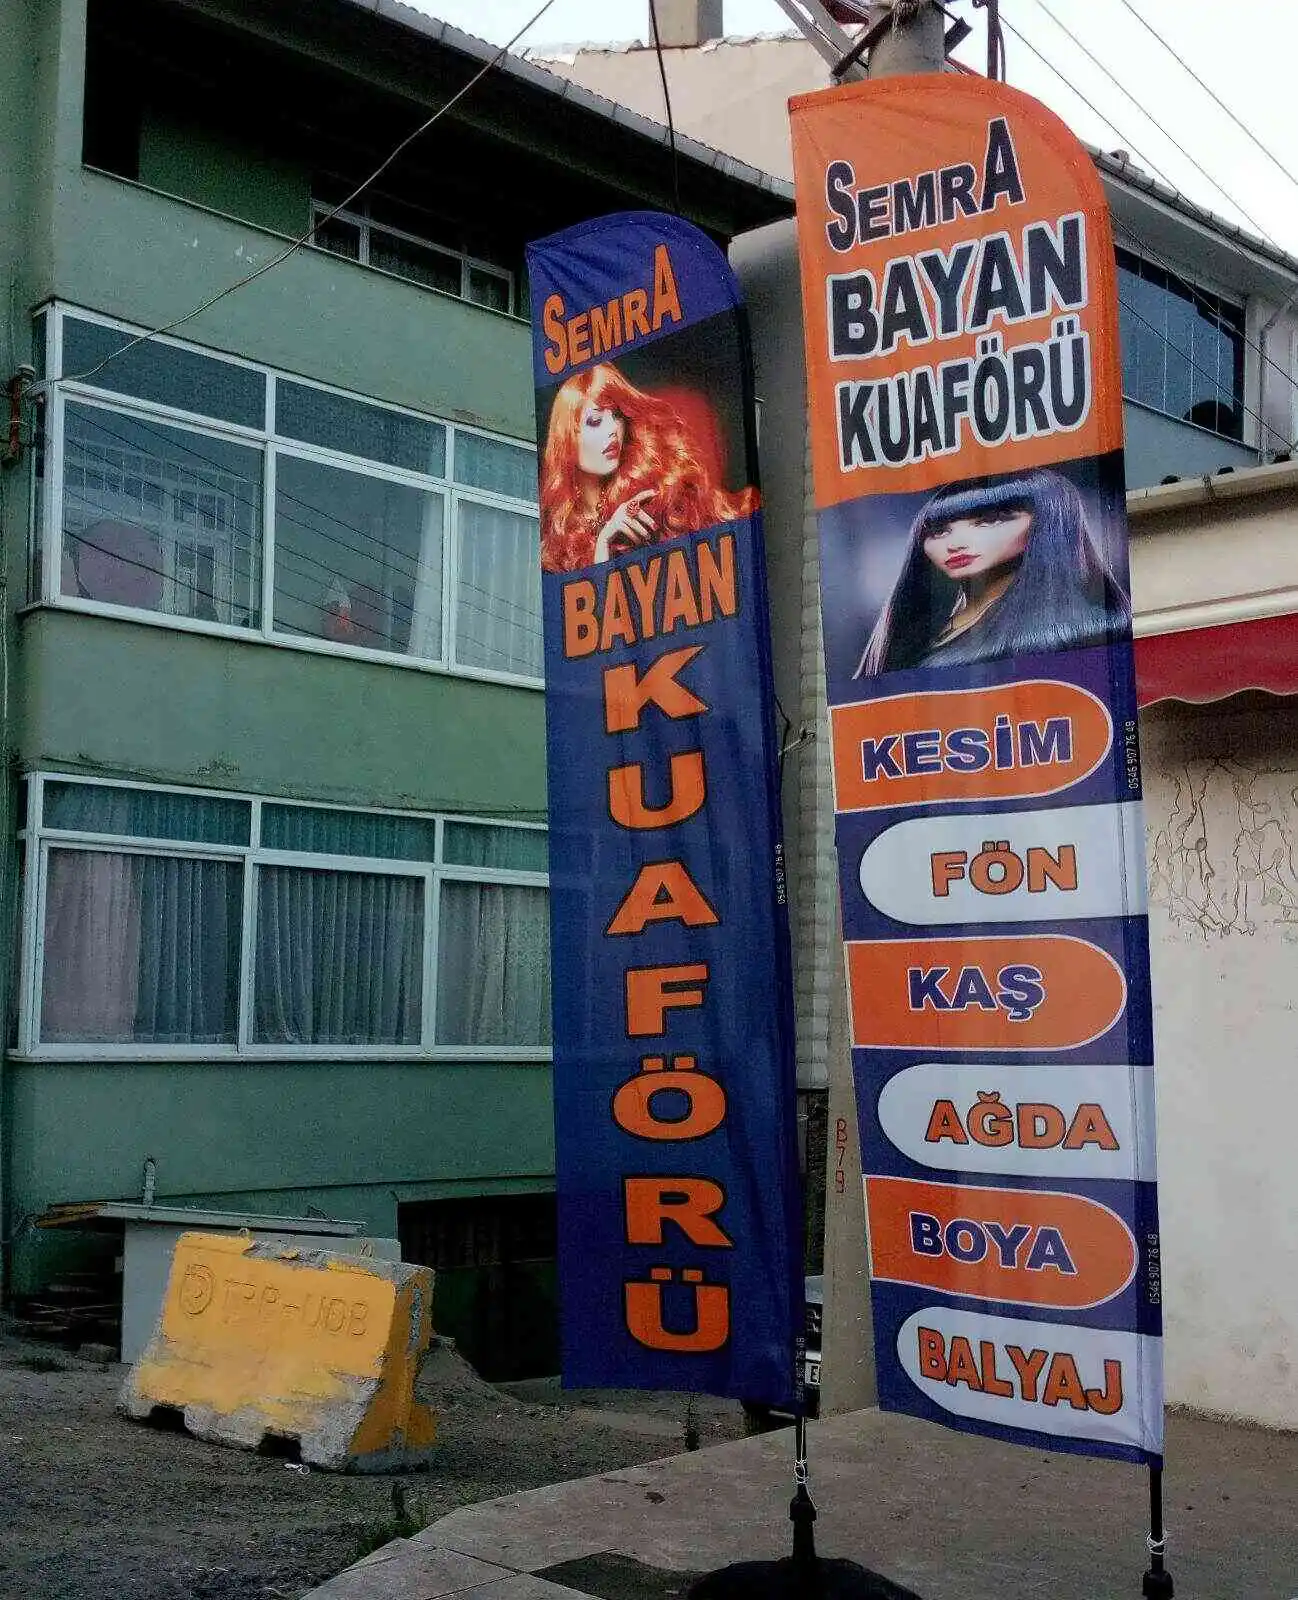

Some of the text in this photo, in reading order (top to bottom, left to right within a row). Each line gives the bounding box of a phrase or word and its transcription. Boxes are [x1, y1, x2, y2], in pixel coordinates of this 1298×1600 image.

[826, 116, 1025, 254] SEMRA
[542, 243, 683, 376] SEMRA
[827, 211, 1087, 363] BAYAN
[834, 316, 1092, 474] KUAFÖRÜ
[563, 535, 738, 660] BAYAN
[861, 715, 1074, 783] KESİM
[930, 841, 1078, 898] FÖN
[604, 647, 733, 1353] KUAFÖRÜ
[906, 963, 1047, 1022] KAŞ
[925, 1091, 1121, 1151] AĞDA
[908, 1211, 1078, 1276] BOYA
[1147, 1233, 1160, 1304] 0546 907 76 48
[917, 1325, 1125, 1417] BALYAJ
